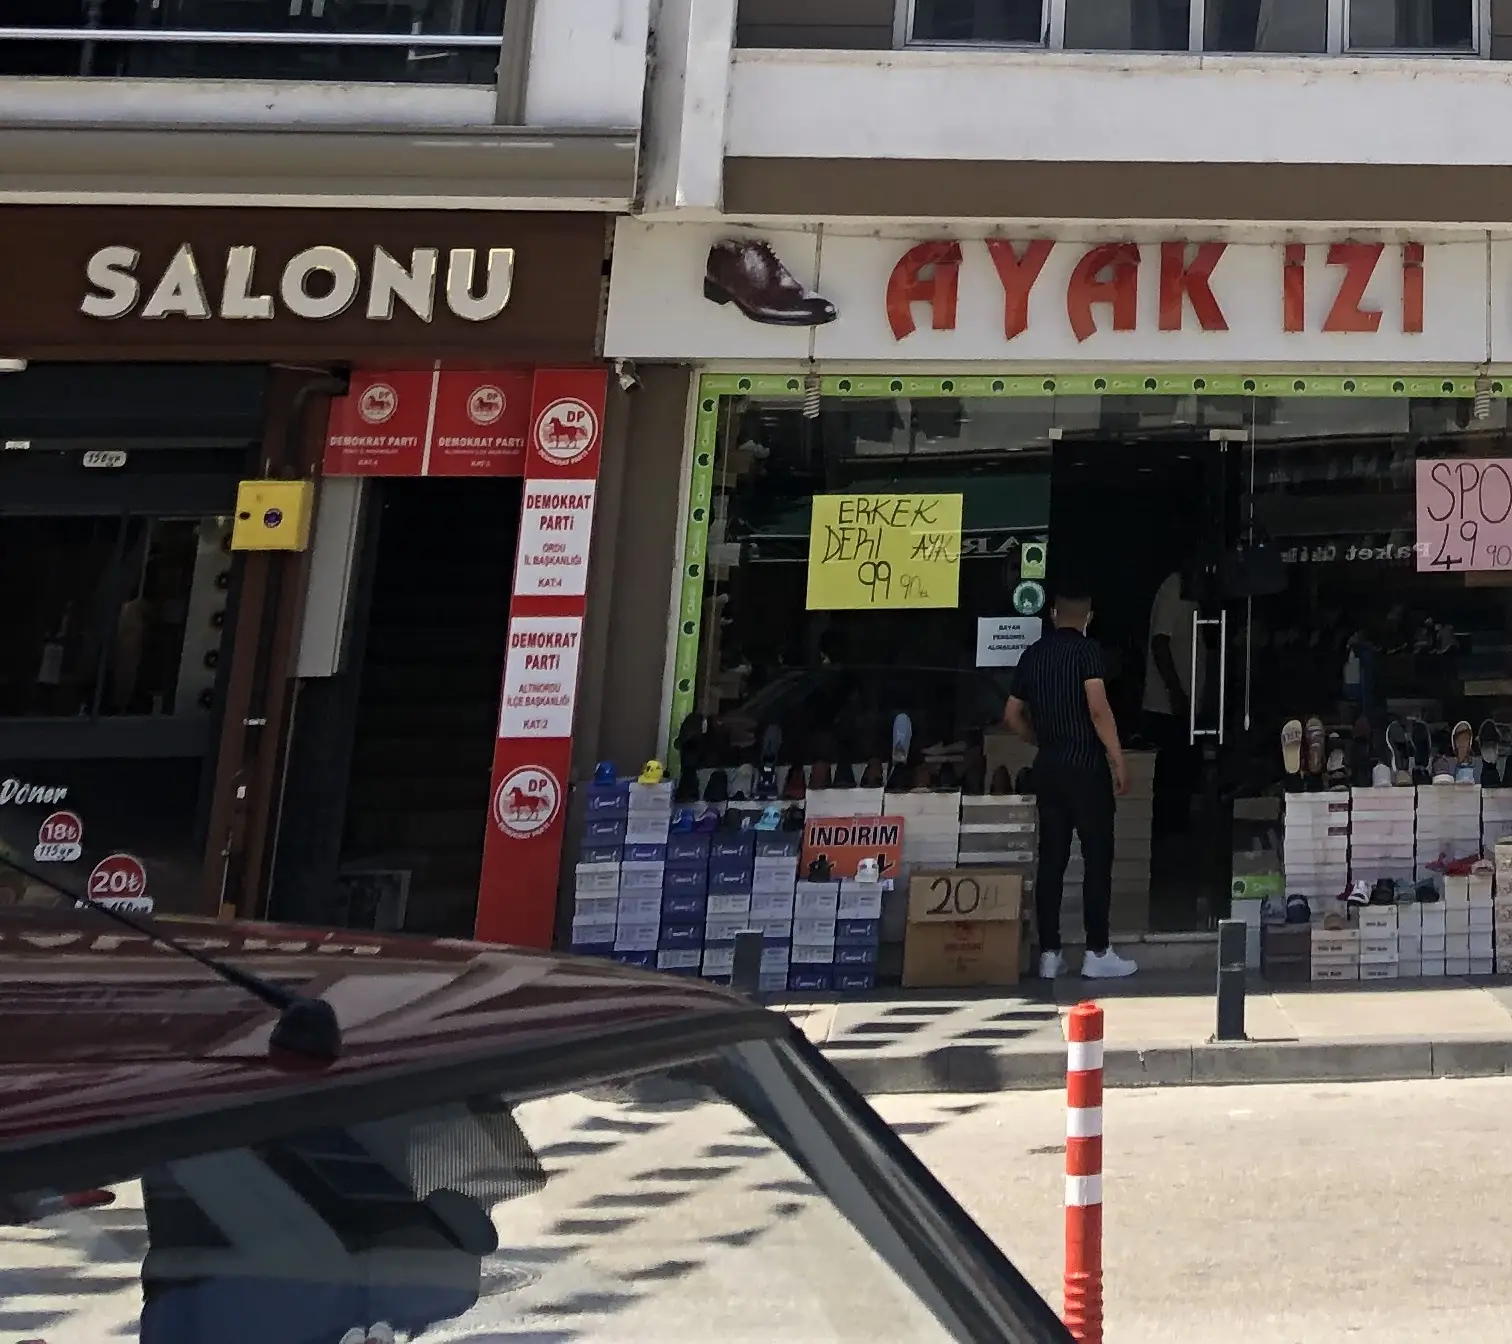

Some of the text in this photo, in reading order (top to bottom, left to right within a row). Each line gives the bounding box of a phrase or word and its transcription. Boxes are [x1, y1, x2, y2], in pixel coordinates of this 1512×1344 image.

[80, 242, 517, 323] SALONU
[886, 238, 1230, 343] AYAK
[566, 410, 586, 423] DP
[329, 436, 386, 447] DEMOKRAT
[438, 437, 493, 447] DEMOKRAT
[526, 494, 591, 510] DEMOKRAT
[838, 497, 940, 528] ERKEK
[542, 542, 566, 553] ORDU
[1429, 520, 1478, 570] 49
[858, 560, 892, 602] 99
[511, 631, 577, 649] DEMOKRAT
[523, 719, 541, 730] KAT
[527, 778, 547, 793] DP
[809, 818, 900, 847] İNDİRİM
[926, 877, 980, 915] 20
